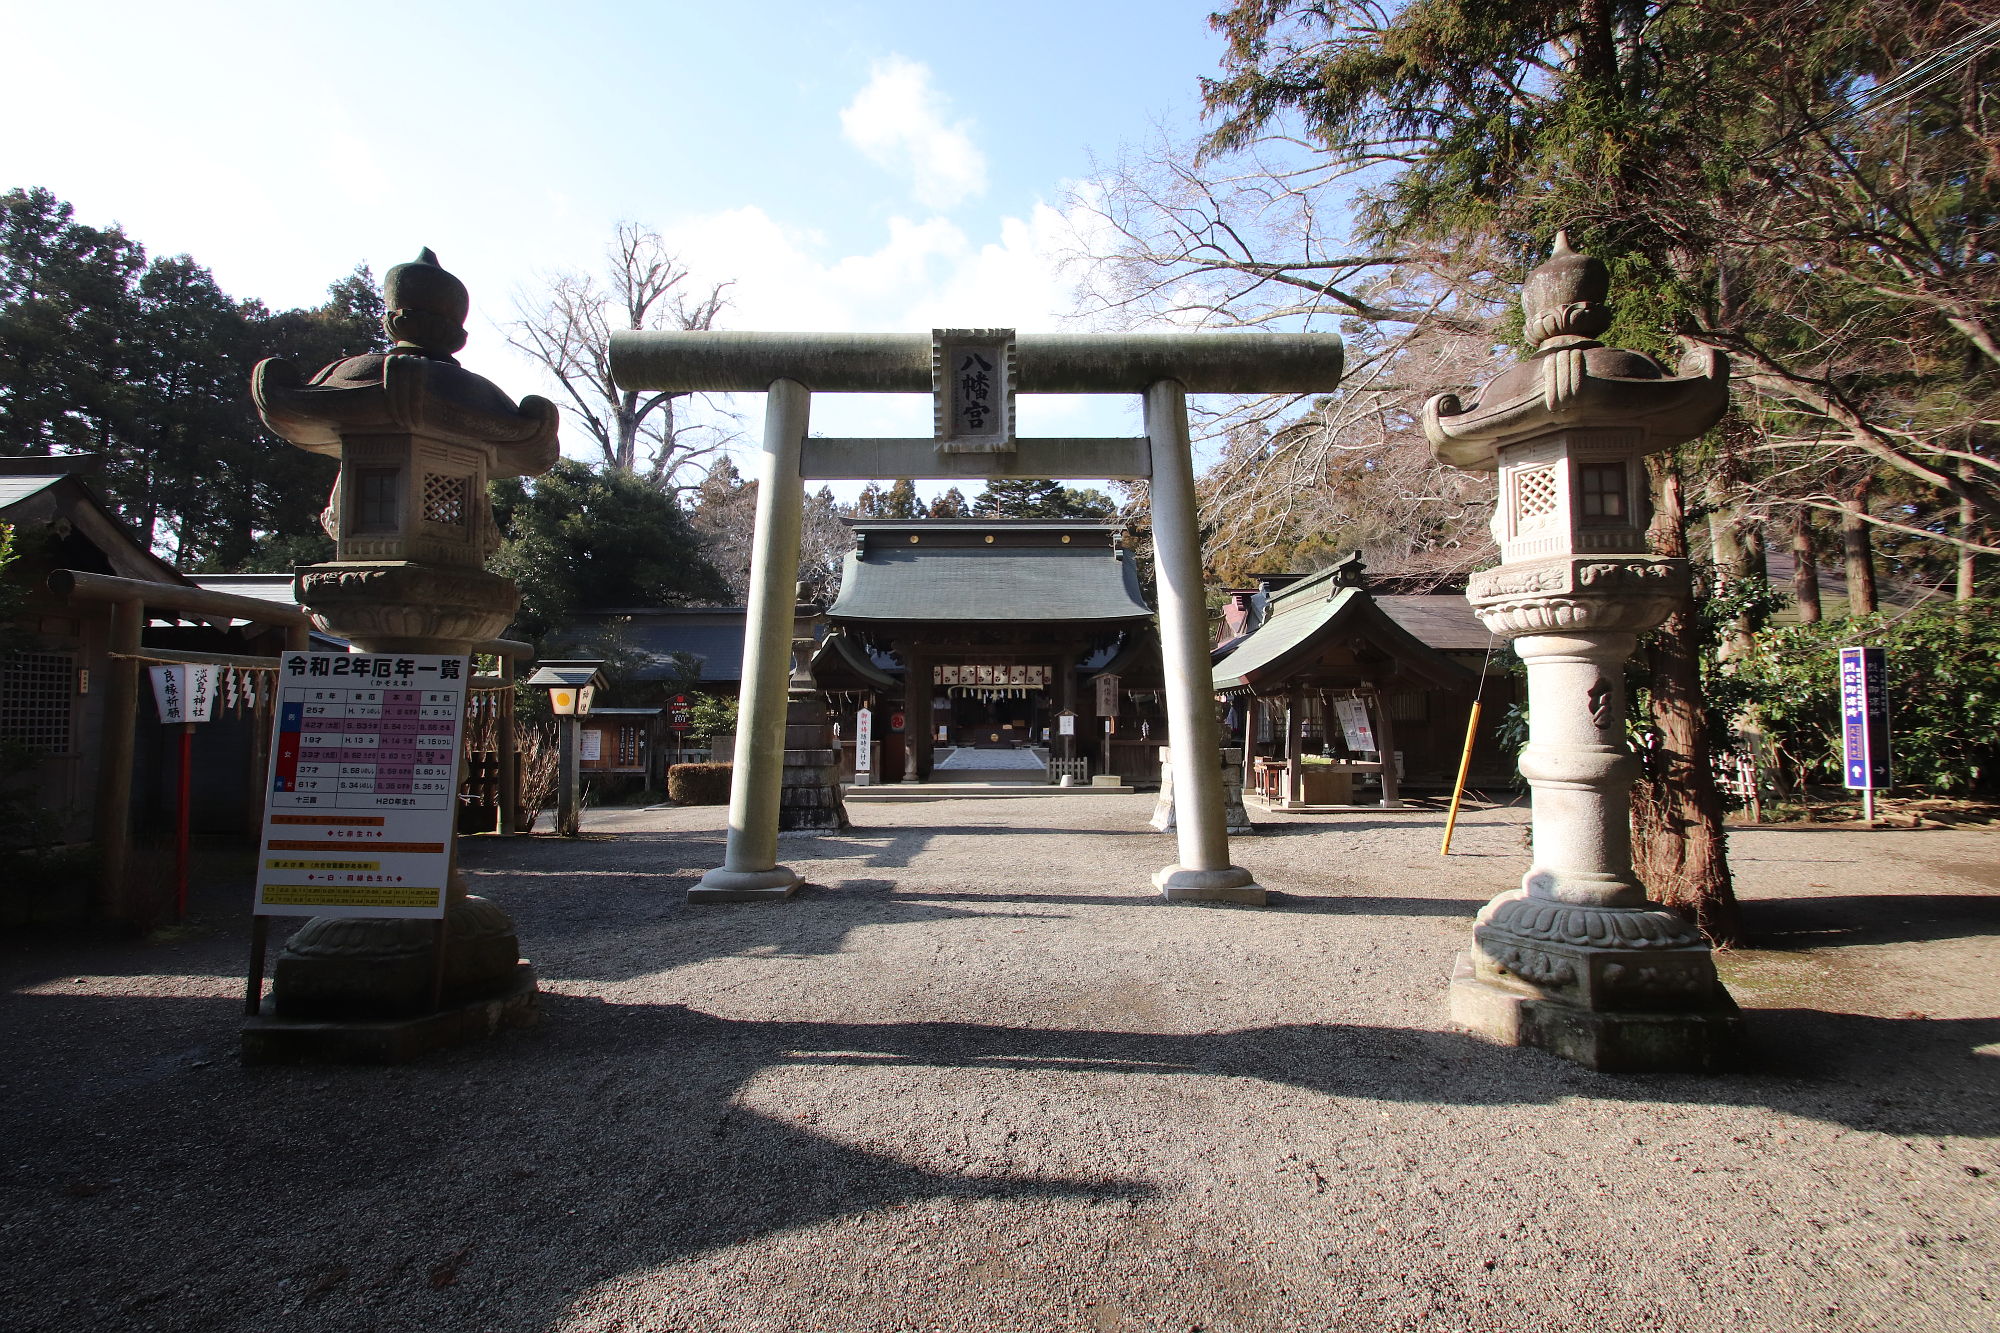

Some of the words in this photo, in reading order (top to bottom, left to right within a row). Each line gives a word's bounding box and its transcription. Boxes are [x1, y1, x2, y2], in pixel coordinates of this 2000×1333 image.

[961, 352, 992, 430] 八幡宮
[192, 668, 208, 717] 淡島神社
[288, 656, 460, 680] 令和2年厄年一覧
[164, 669, 180, 718] 良縁祈願
